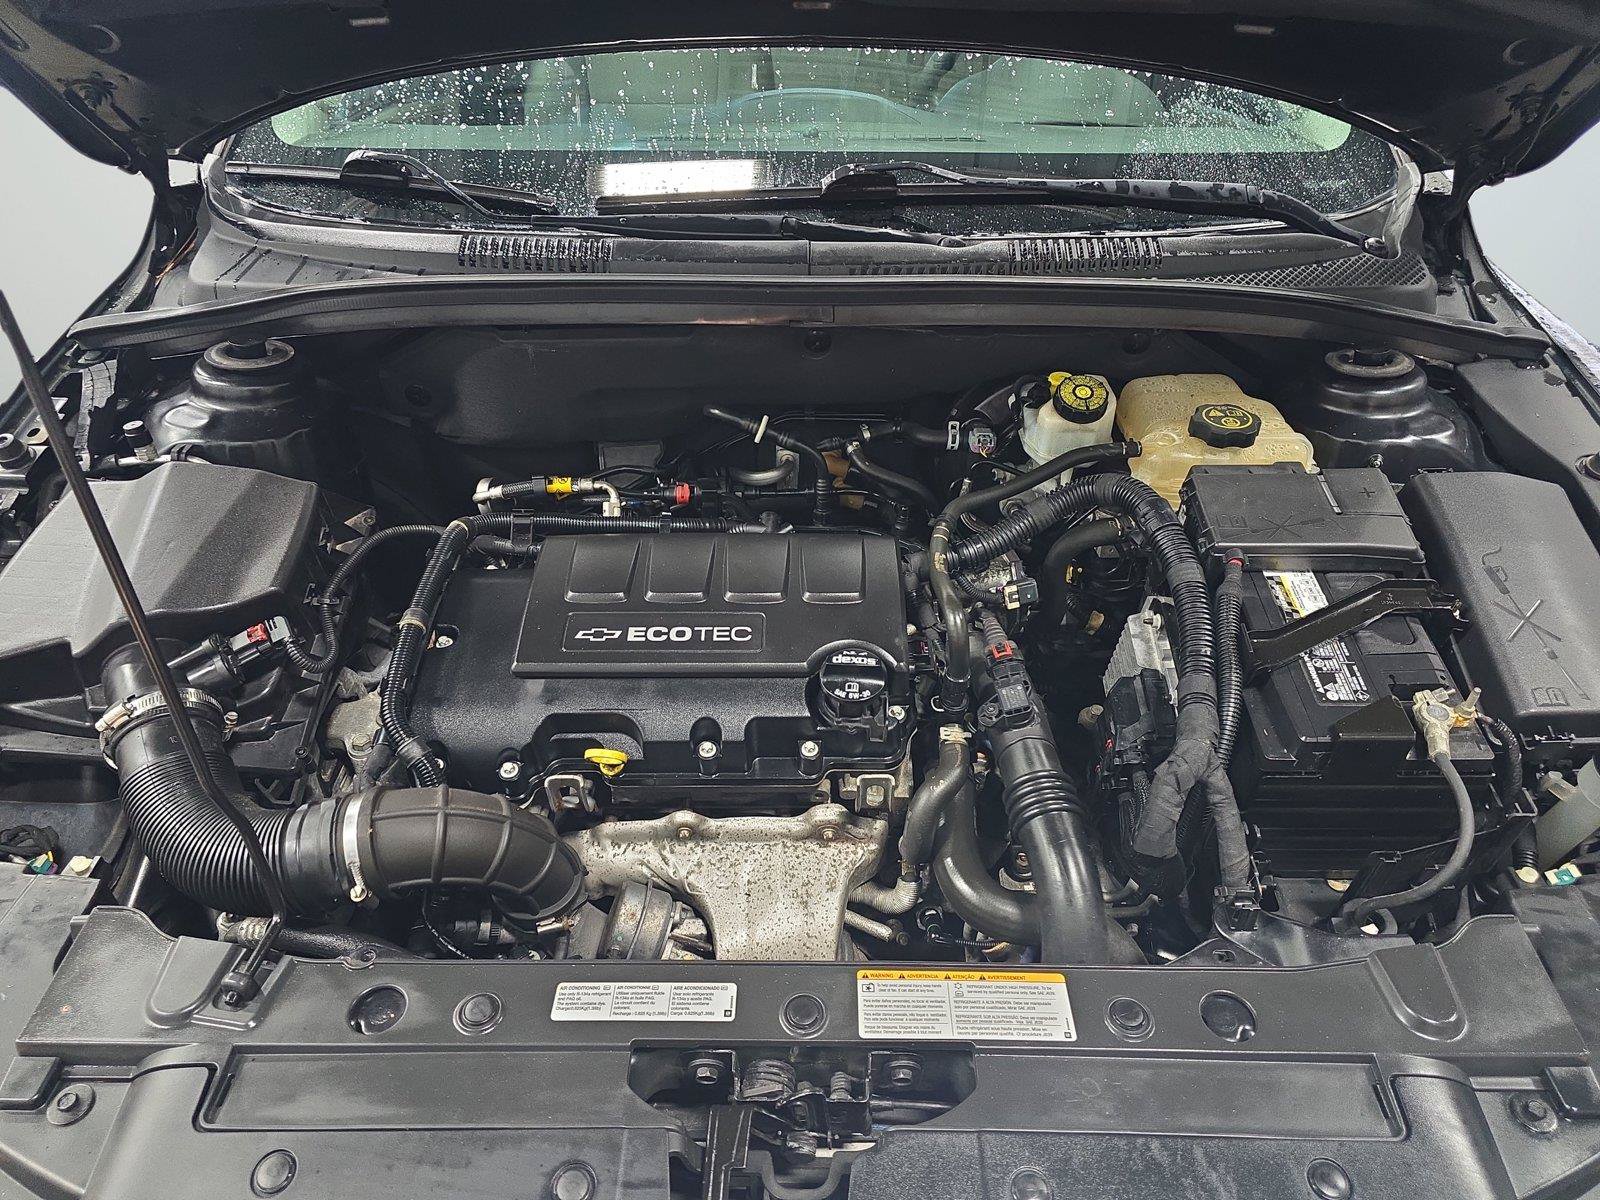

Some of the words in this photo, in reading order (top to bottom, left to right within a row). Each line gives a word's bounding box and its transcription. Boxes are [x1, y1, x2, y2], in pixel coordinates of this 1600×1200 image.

[627, 625, 753, 642] ECOTEC
[832, 654, 876, 665] dexos
[834, 688, 847, 698] SAE
[848, 689, 871, 699] 5W-30
